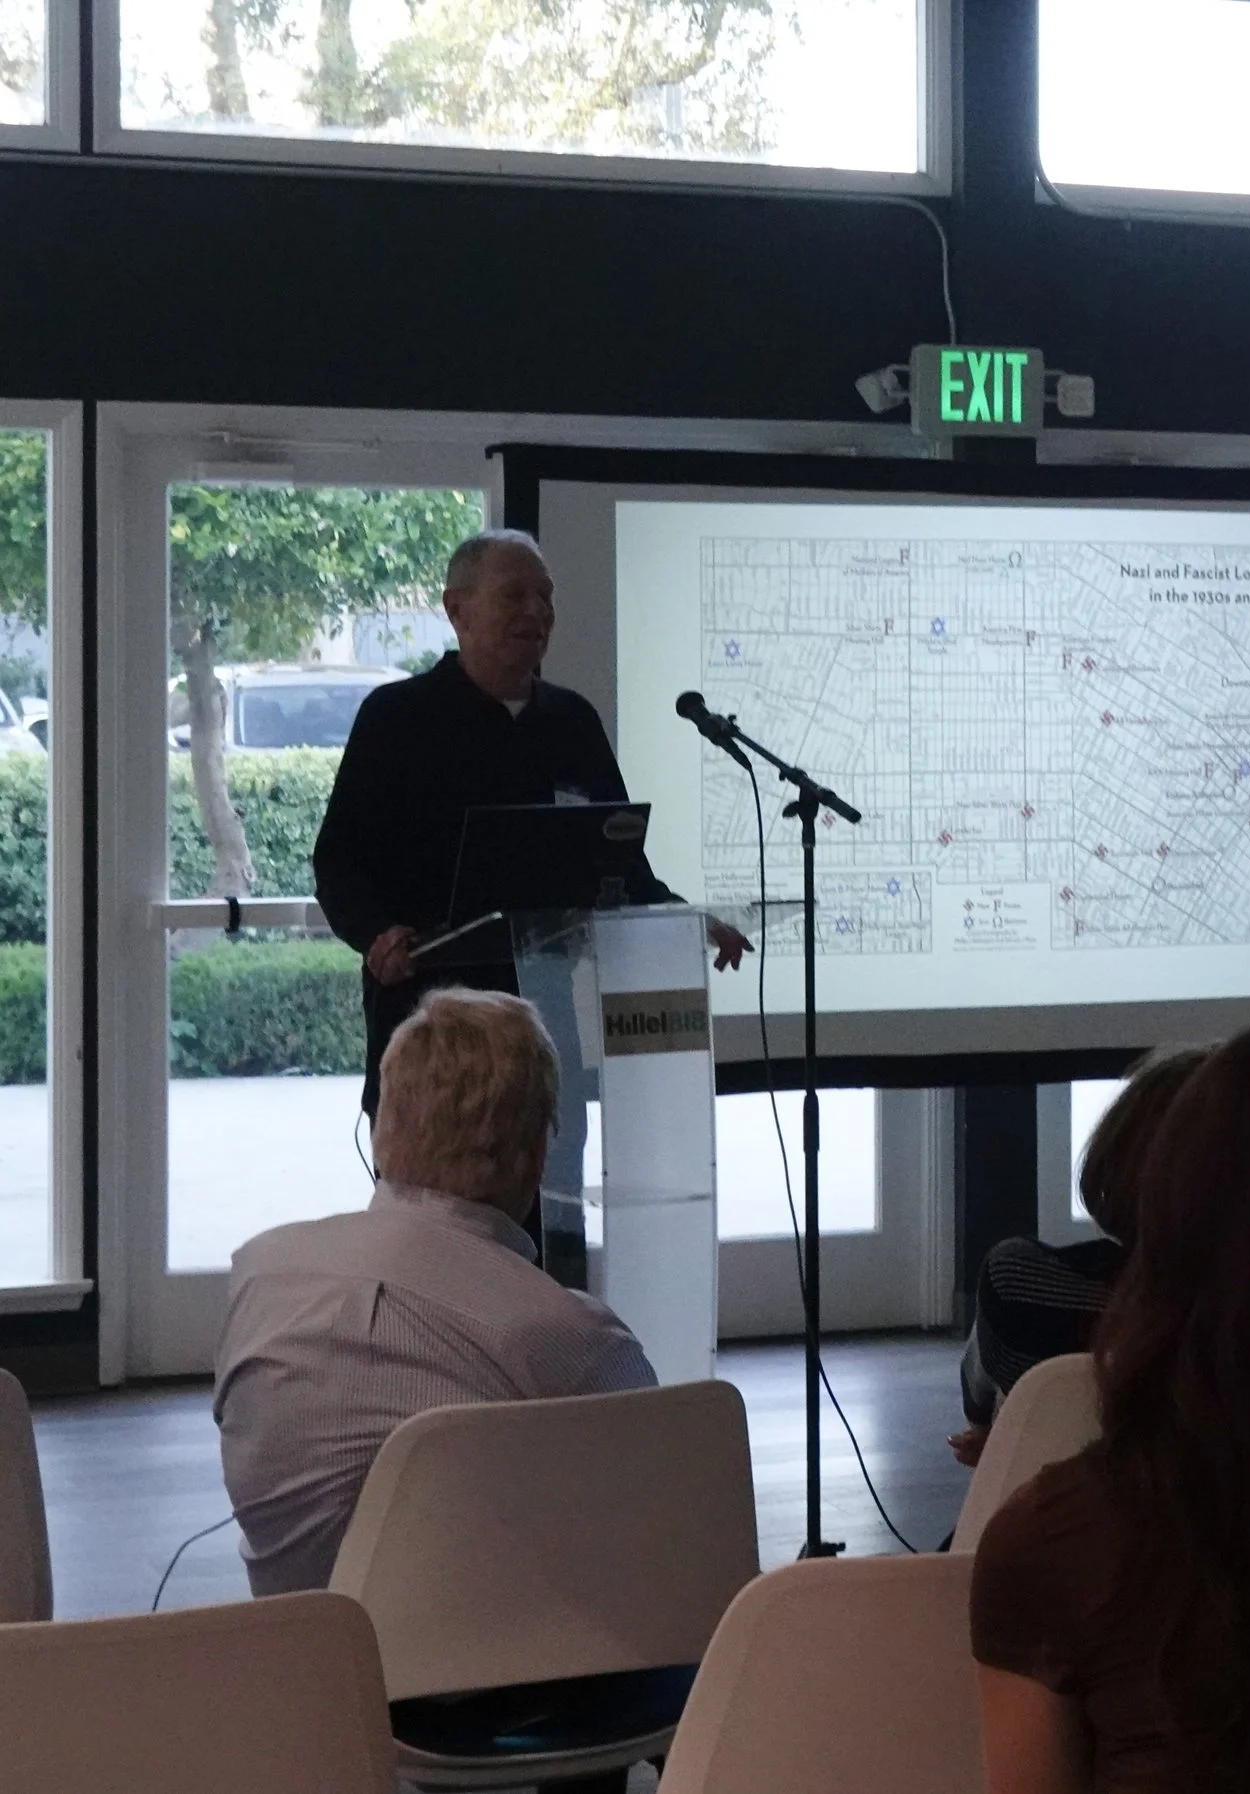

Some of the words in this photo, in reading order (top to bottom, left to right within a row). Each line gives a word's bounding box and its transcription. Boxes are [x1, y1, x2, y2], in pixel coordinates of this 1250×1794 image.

[940, 350, 1029, 424] EXIT
[1155, 564, 1180, 580] and
[1183, 565, 1230, 581] Fascist
[1149, 587, 1162, 603] in
[1166, 588, 1189, 604] the
[1193, 590, 1231, 606] 1930s
